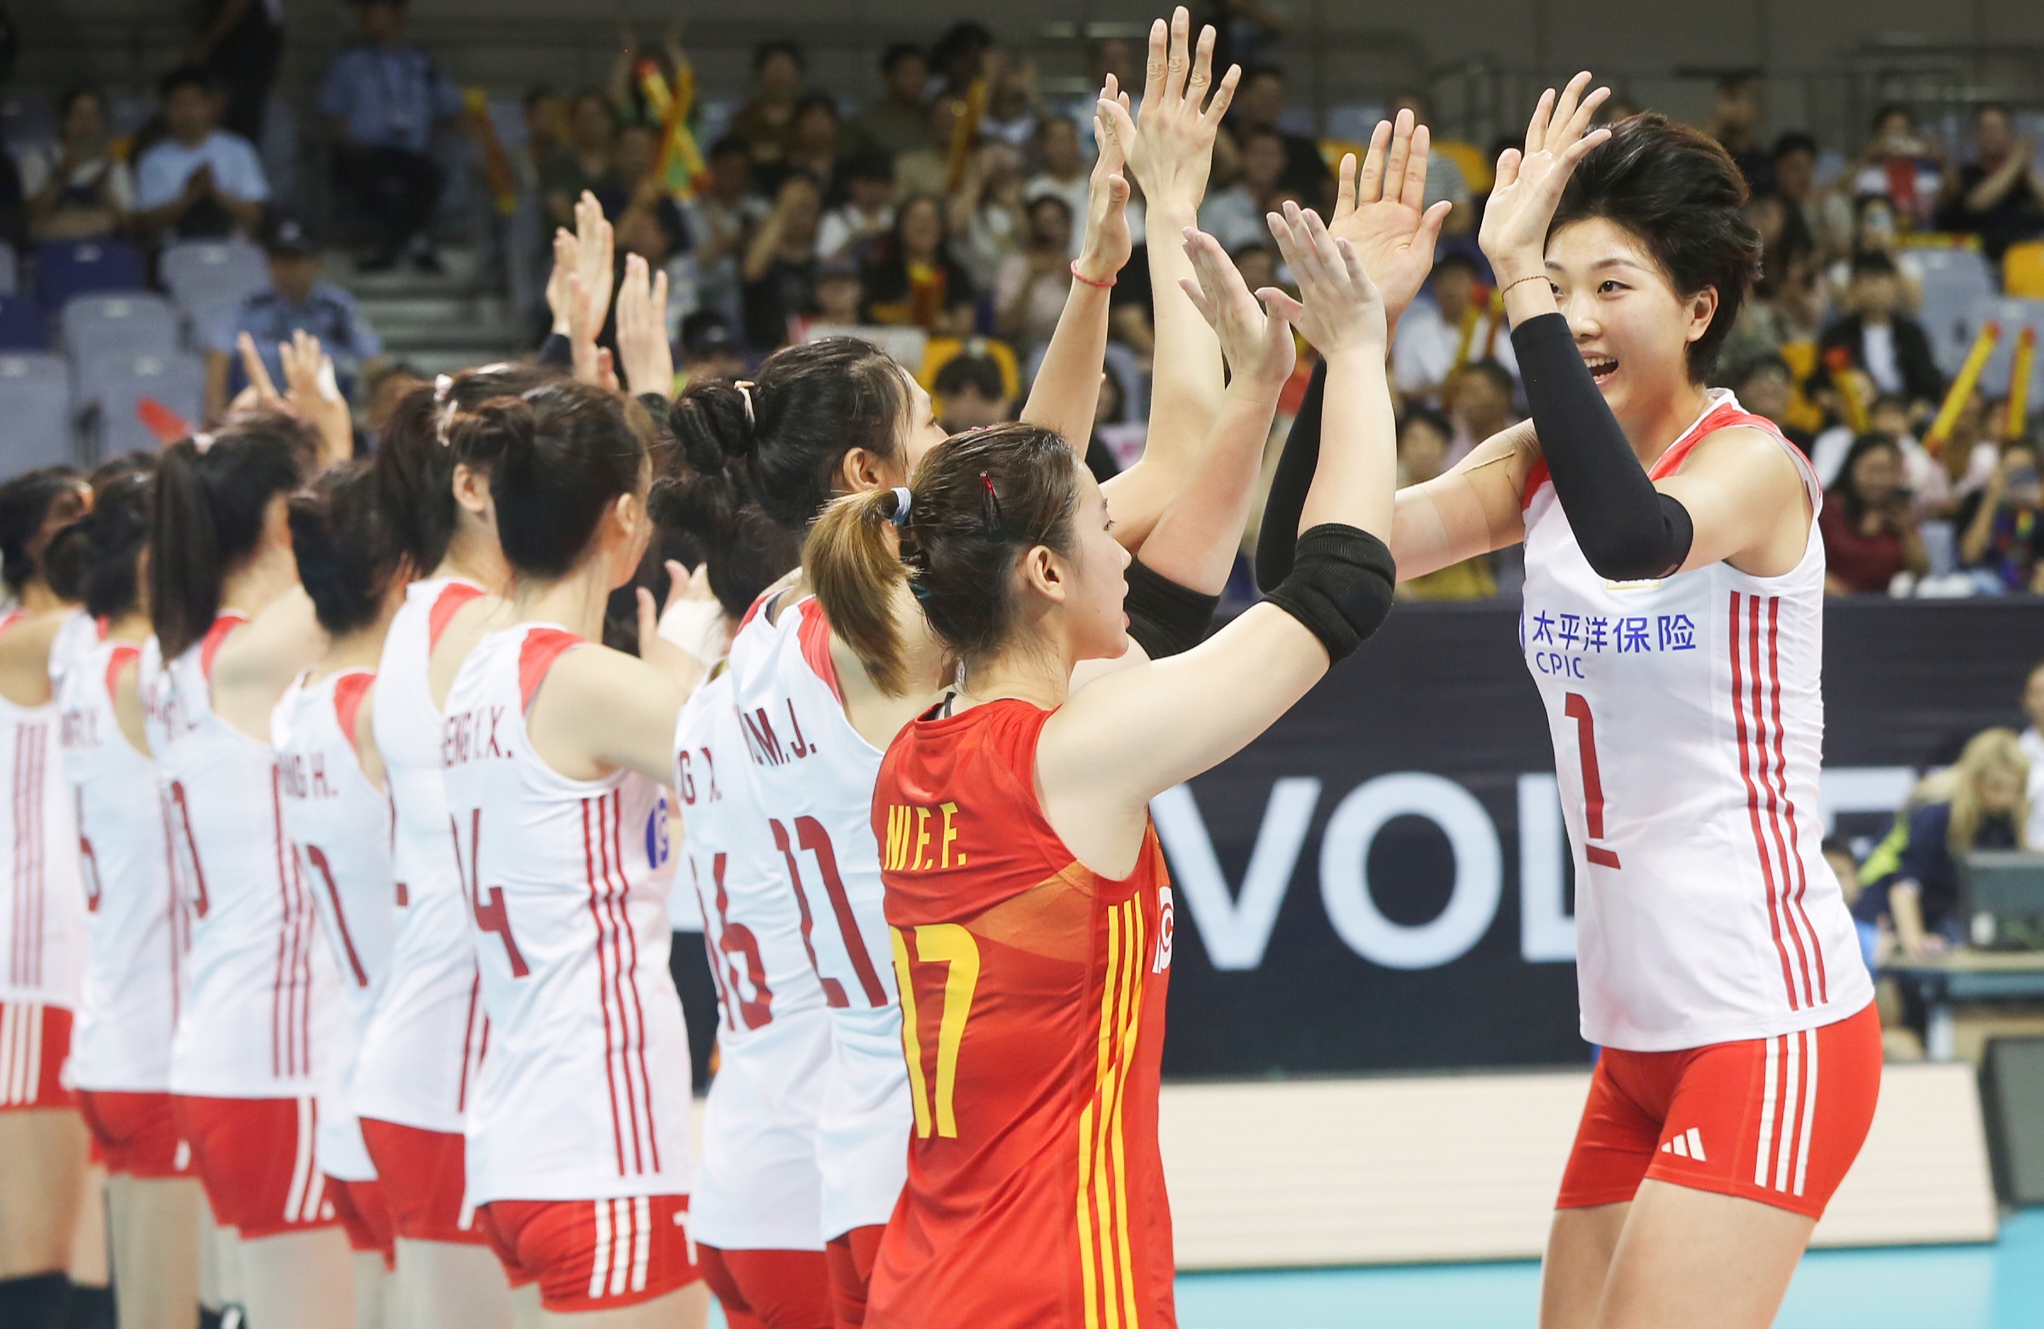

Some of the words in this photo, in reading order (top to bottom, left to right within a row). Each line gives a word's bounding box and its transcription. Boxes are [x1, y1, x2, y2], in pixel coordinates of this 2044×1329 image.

[1532, 609, 1696, 653] 太平洋保险
[1535, 651, 1586, 679] CPIC
[1564, 691, 1605, 840] 1
[889, 922, 981, 1139] 17
